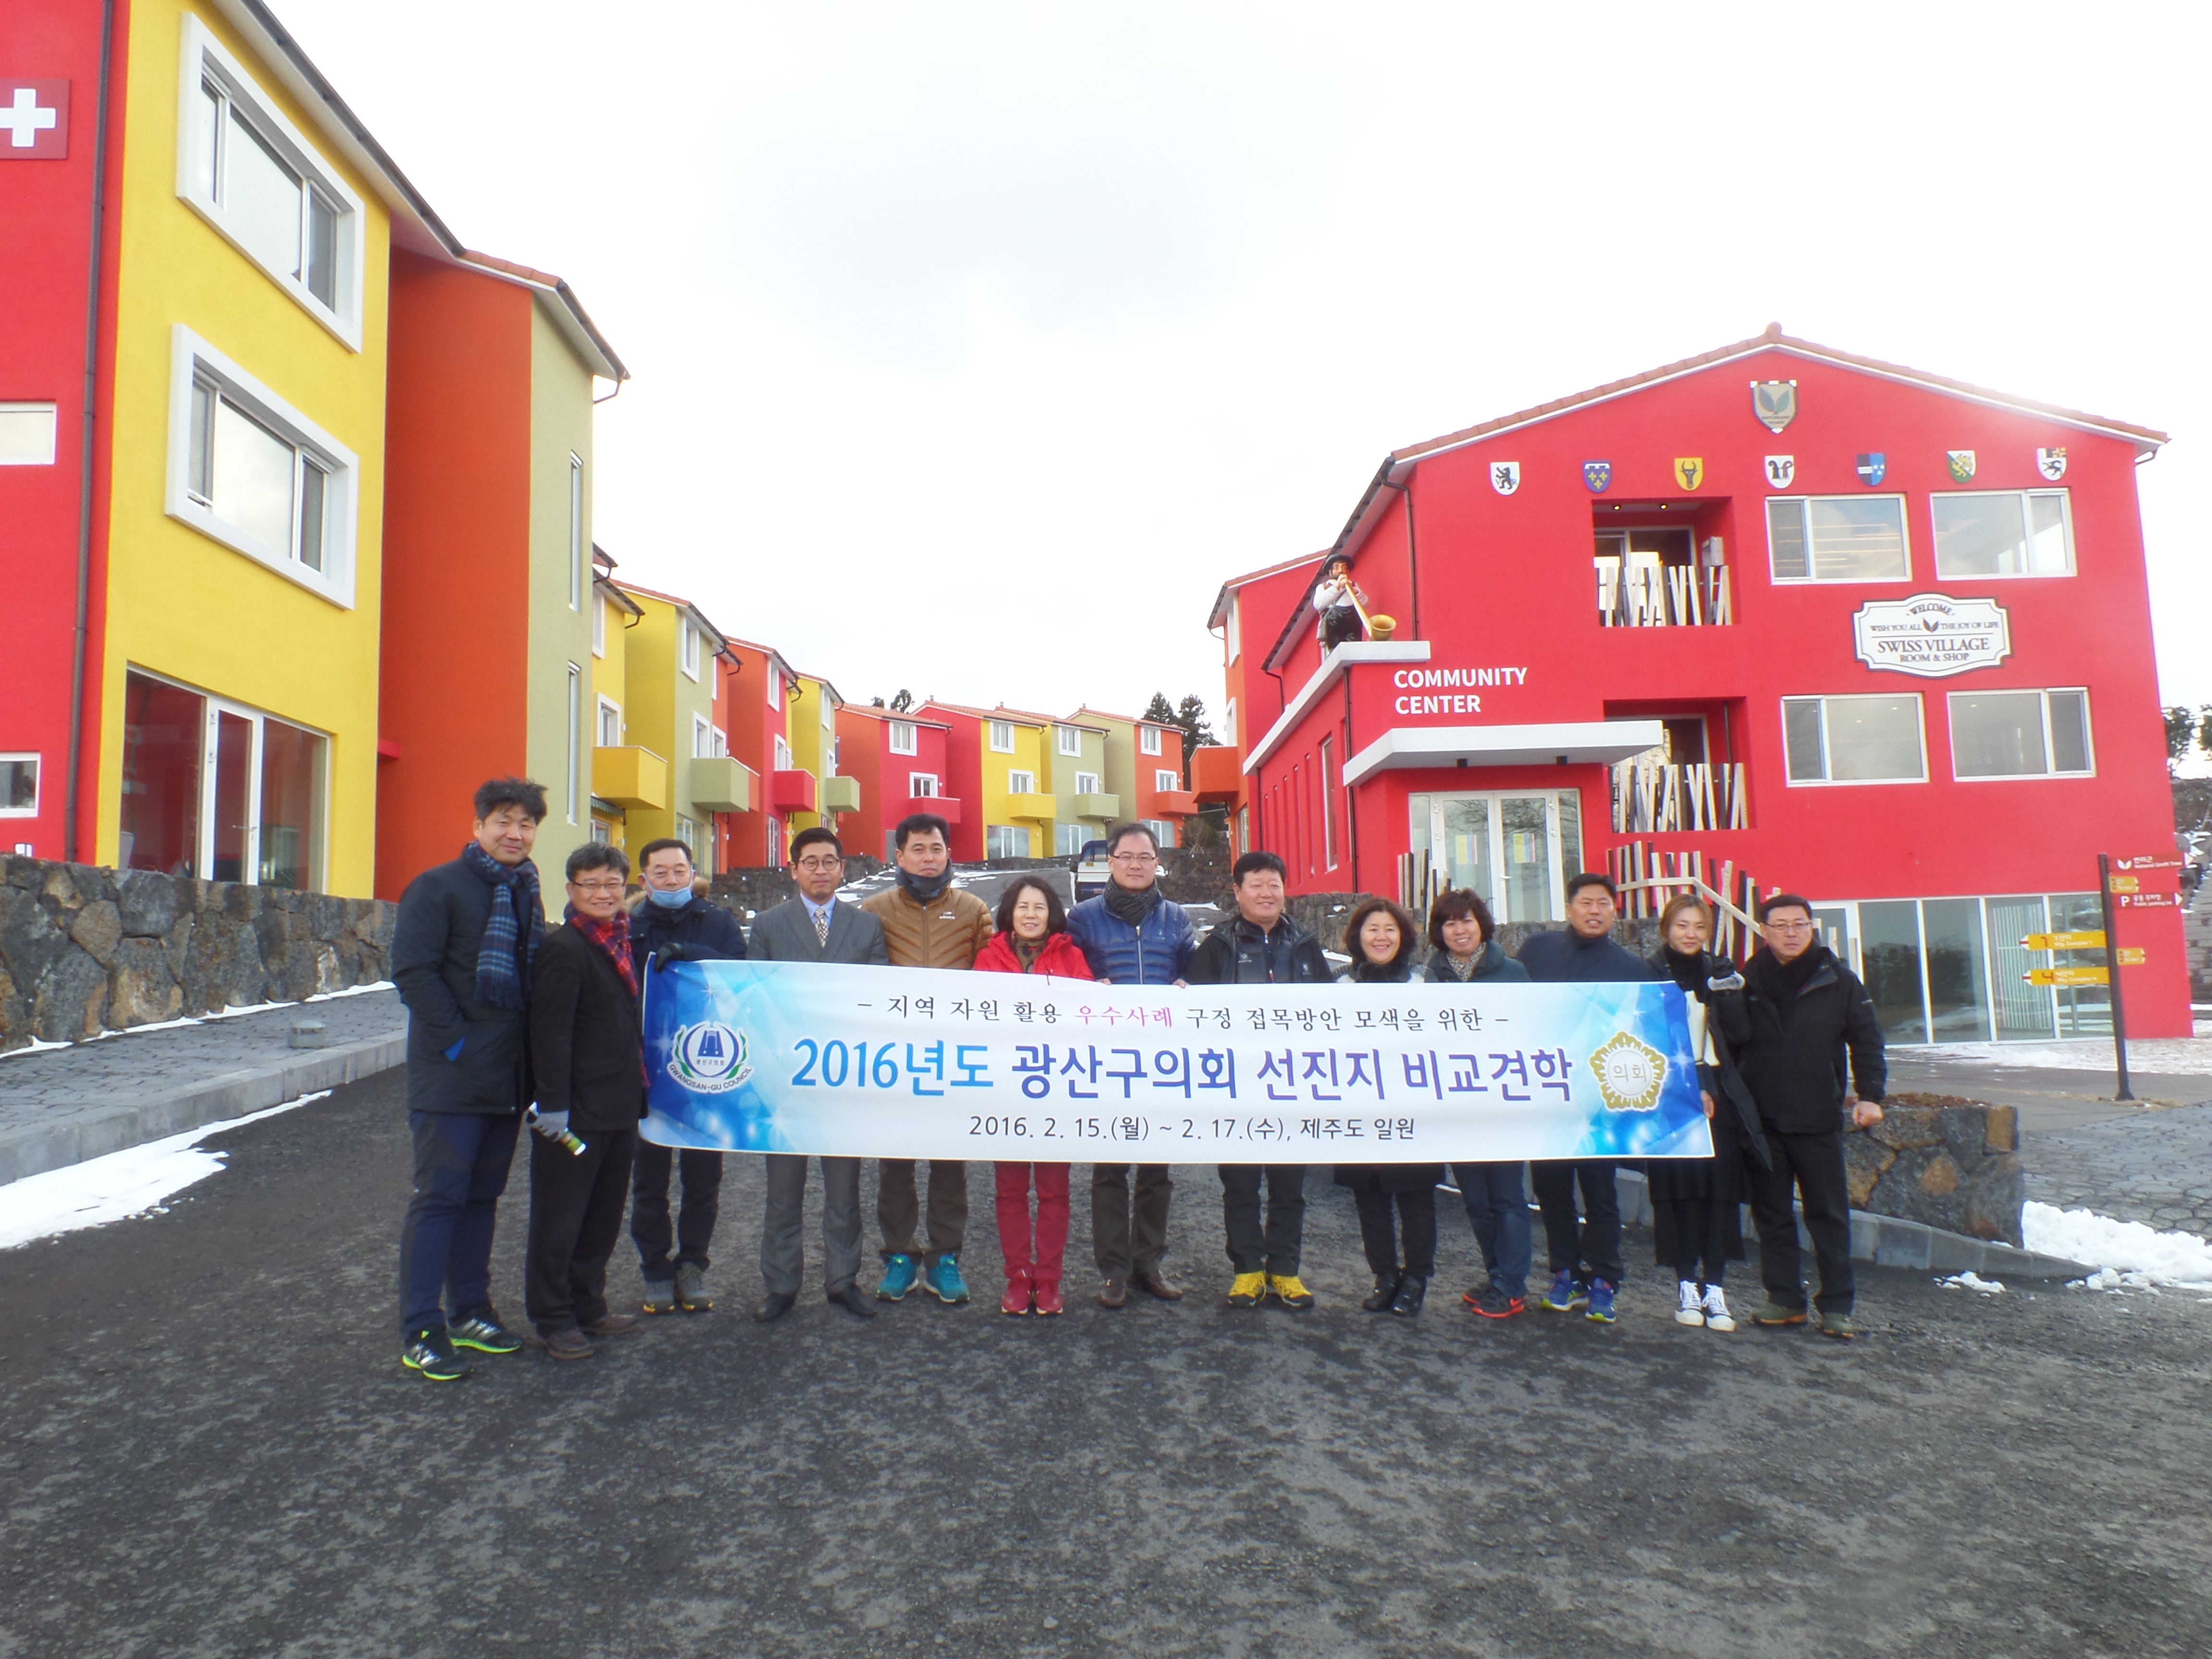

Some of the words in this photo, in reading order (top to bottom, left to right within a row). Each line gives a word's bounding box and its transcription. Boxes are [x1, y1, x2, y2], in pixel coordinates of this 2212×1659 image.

[1909, 603, 1953, 615] WELCOME
[1957, 622, 1970, 630] JOY
[1877, 640, 1922, 653] SWISS
[1924, 638, 1990, 651] VILLAGE
[1900, 654, 1930, 662] ROOM
[1933, 653, 1941, 661] &
[1944, 653, 1970, 661] SHOP
[1394, 667, 1527, 688] COMMUNITY
[1395, 695, 1481, 715] CENTER
[2120, 895, 2130, 907] P
[888, 995, 934, 1020] 지역
[950, 998, 1000, 1022] 자원
[1013, 1001, 1061, 1024] 활용
[1076, 1005, 1172, 1028] 우수사례
[1187, 1007, 1231, 1030] 구정
[1246, 1007, 1342, 1032] 접목방안
[1354, 1008, 1425, 1032] 모색을
[1438, 1008, 1483, 1032] 위한
[670, 1064, 721, 1090] GWANGSAN-GU
[723, 1067, 752, 1088] COUNCIL
[791, 1038, 994, 1097] 2016년도
[1011, 1043, 1238, 1100] 광산구의회
[1256, 1048, 1386, 1101] 선진지
[1401, 1047, 1574, 1102] 비교견학
[1613, 1063, 1647, 1082] 의회
[969, 1115, 1034, 1139] 2016.
[1043, 1117, 1064, 1139] 2.
[1075, 1116, 1149, 1142] 15.(월)
[1181, 1118, 1202, 1140] 2.
[1212, 1117, 1291, 1142] 17.(수),
[1300, 1118, 1365, 1140] 제주도
[1373, 1118, 1415, 1141] 일원
